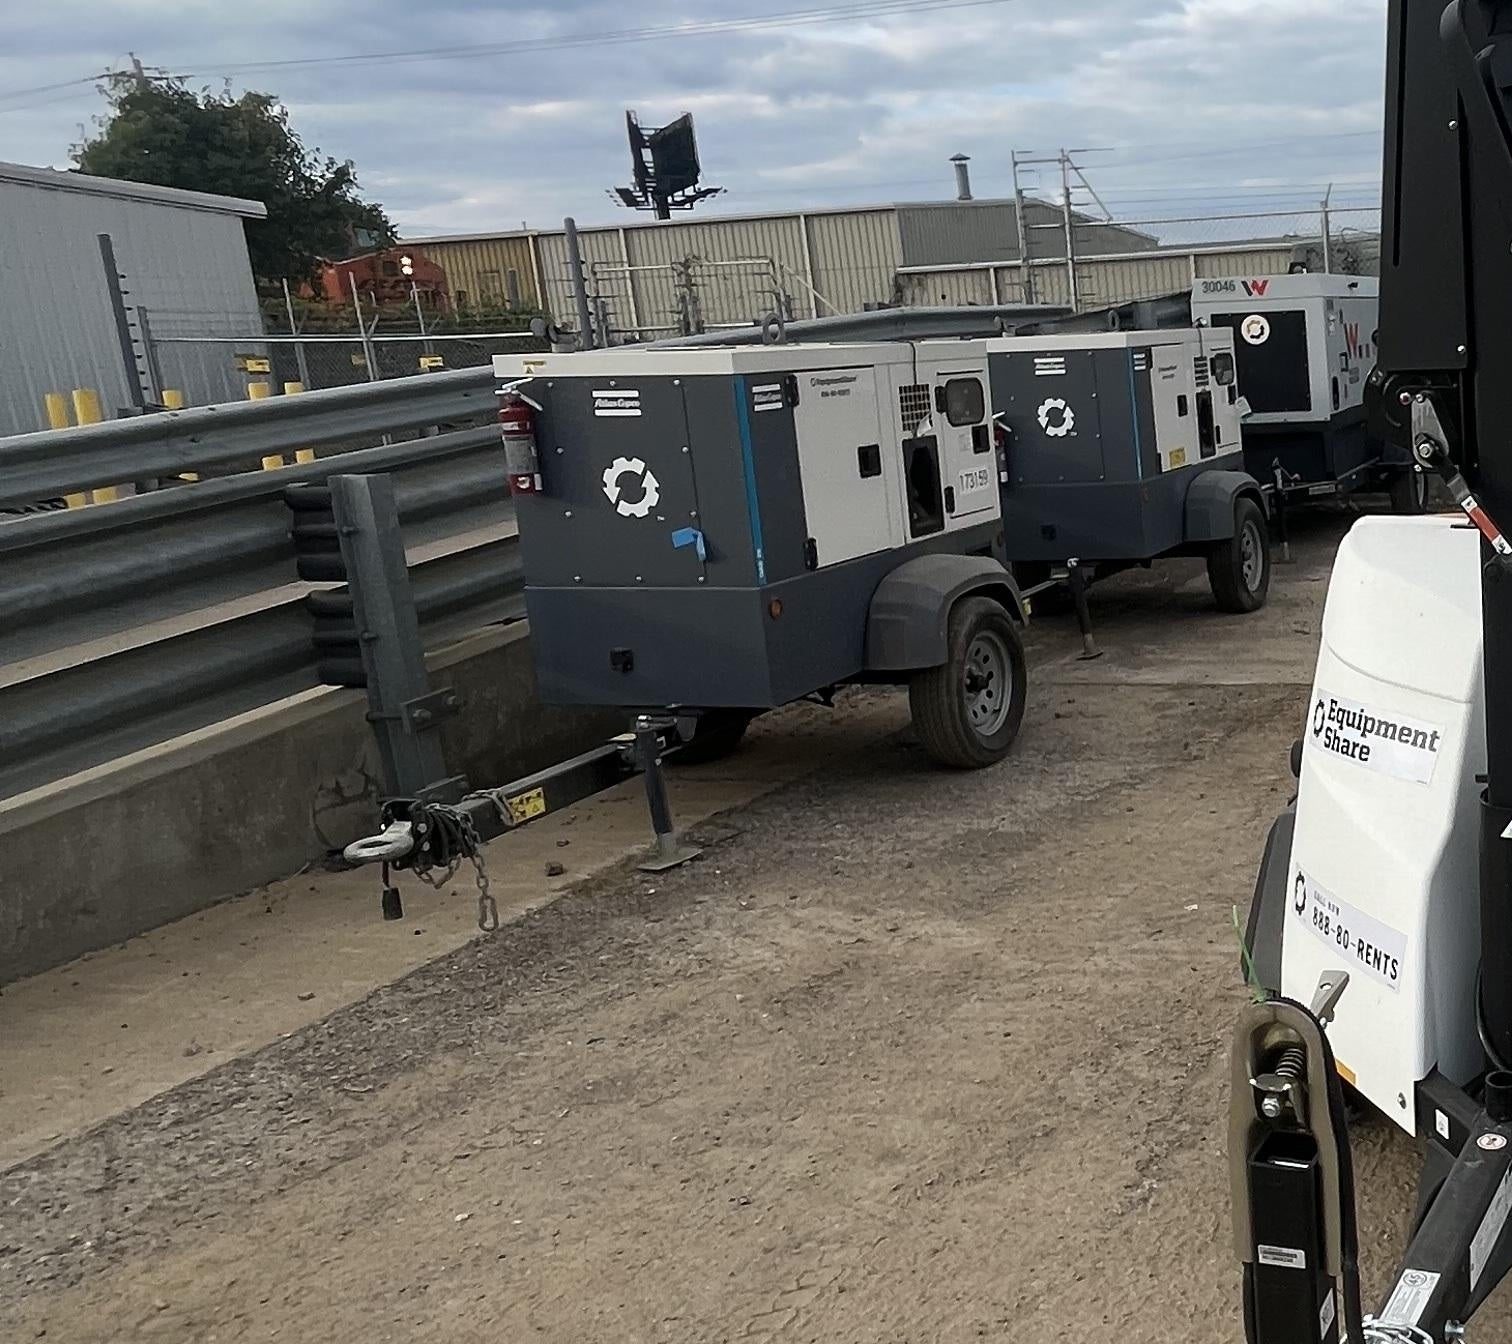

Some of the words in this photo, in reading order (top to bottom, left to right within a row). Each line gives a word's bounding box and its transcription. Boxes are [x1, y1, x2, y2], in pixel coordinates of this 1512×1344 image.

[1202, 279, 1236, 294] 30046
[1323, 726, 1371, 762] Share
[1327, 698, 1441, 753] Equipment
[1312, 906, 1399, 981] 888-80-RENTS
